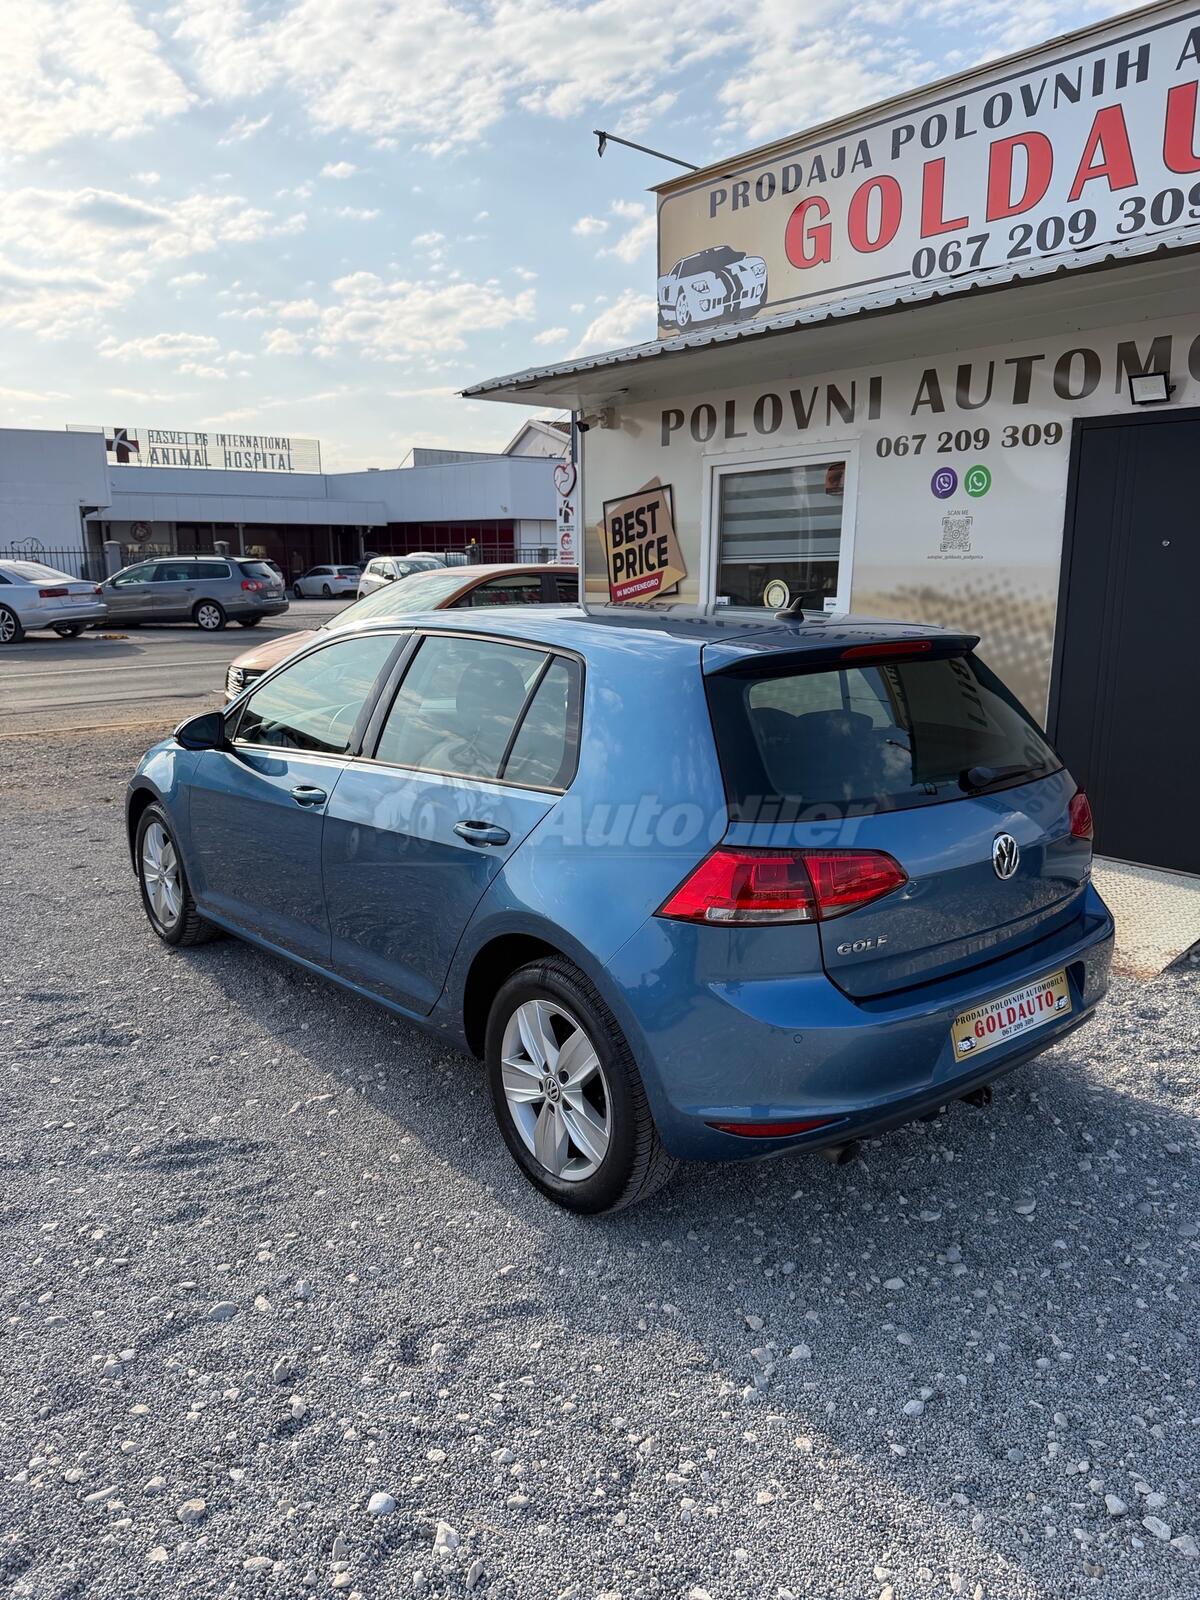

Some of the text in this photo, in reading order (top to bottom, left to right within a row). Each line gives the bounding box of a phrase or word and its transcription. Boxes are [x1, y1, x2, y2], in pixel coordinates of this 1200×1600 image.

[710, 139, 872, 218] PRODAJA
[891, 43, 1151, 160] POLOVNIH
[912, 233, 990, 279] 067
[1006, 208, 1097, 260] 209
[661, 334, 1200, 447] POLOVNI AUTOM
[151, 448, 295, 471] ANIMAL HOSPITAL
[216, 434, 292, 450] INTERNATIONAL
[876, 421, 1064, 458] 067 209 309
[611, 501, 660, 549] BEST
[612, 535, 669, 583] PRICE
[623, 578, 659, 596] MONTENEGRO
[836, 934, 888, 956] GOLF
[955, 976, 1064, 1026] PRODAJA POLOVNIH AUTOMOBILA
[974, 990, 1055, 1038] GOLDAUTO
[1001, 1028, 1012, 1036] 067
